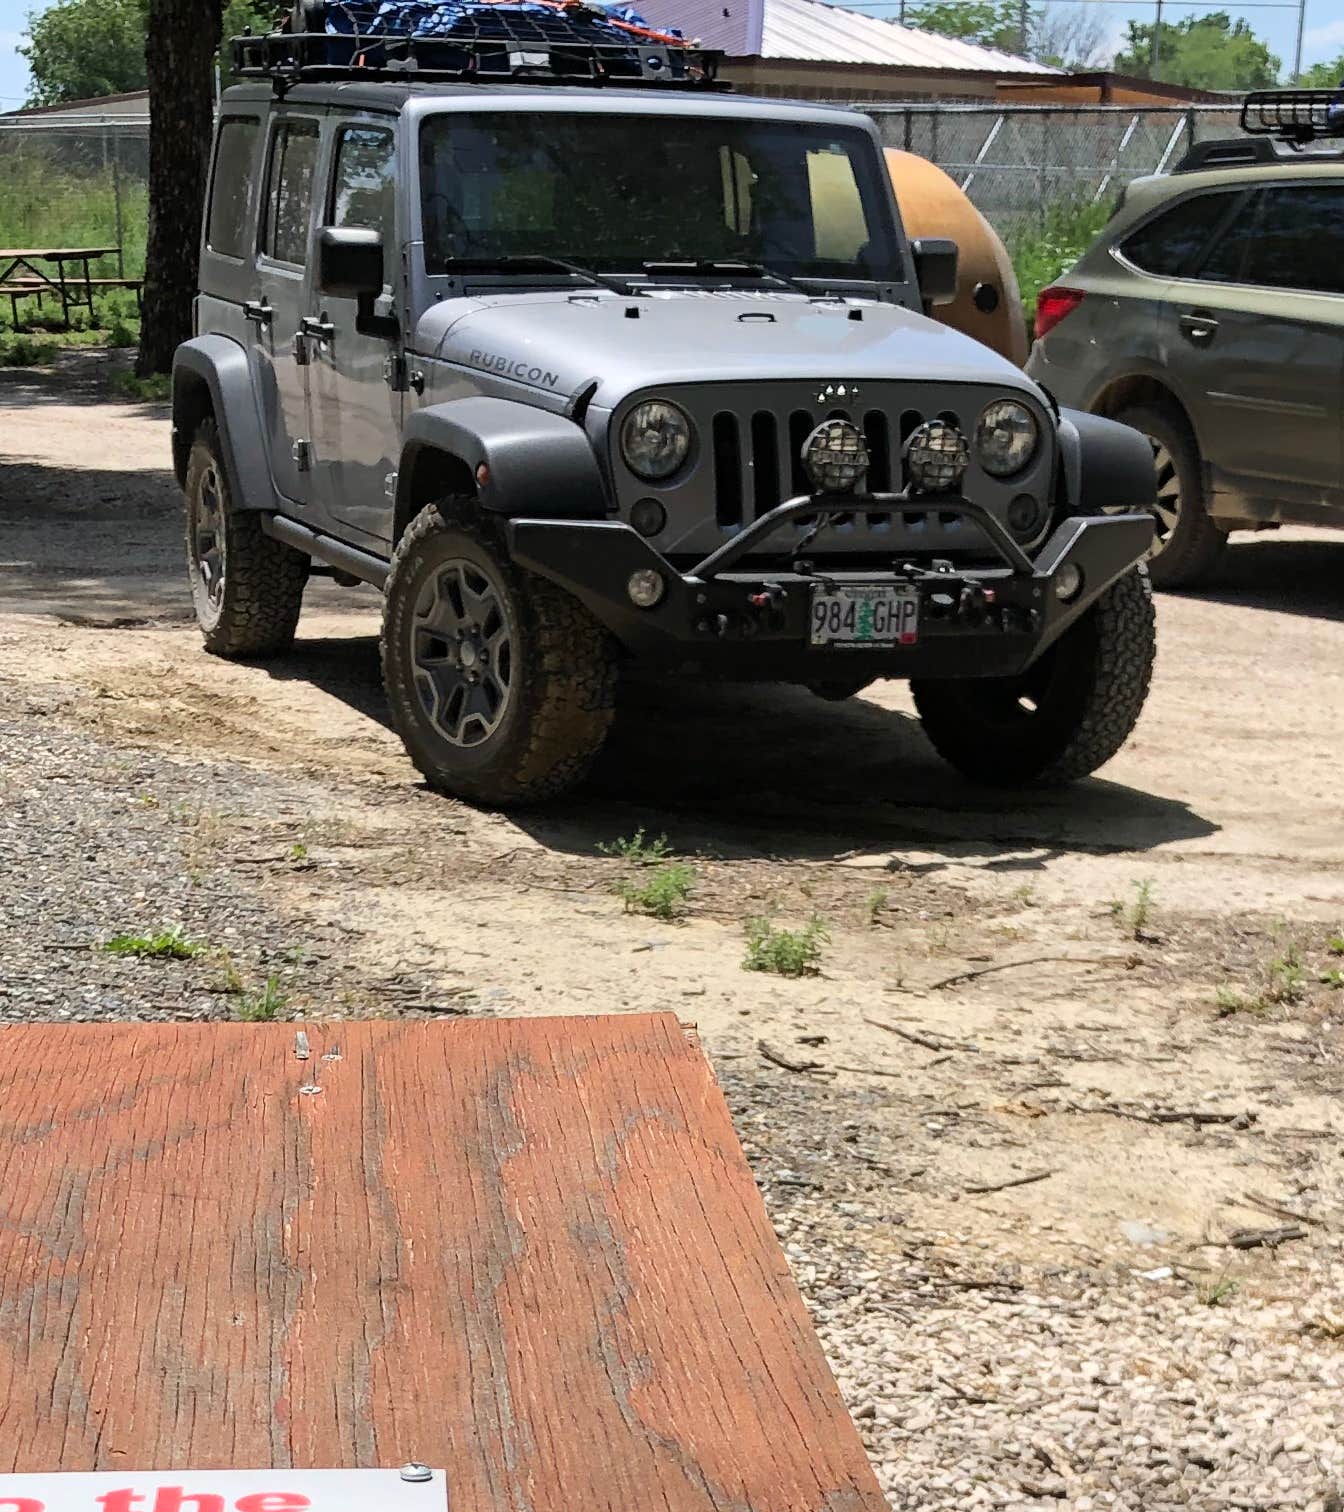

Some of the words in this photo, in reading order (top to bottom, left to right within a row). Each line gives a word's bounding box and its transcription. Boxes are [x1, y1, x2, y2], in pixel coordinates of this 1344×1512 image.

[470, 348, 559, 387] RUBICON
[815, 601, 856, 634] 984
[873, 600, 915, 633] GHP
